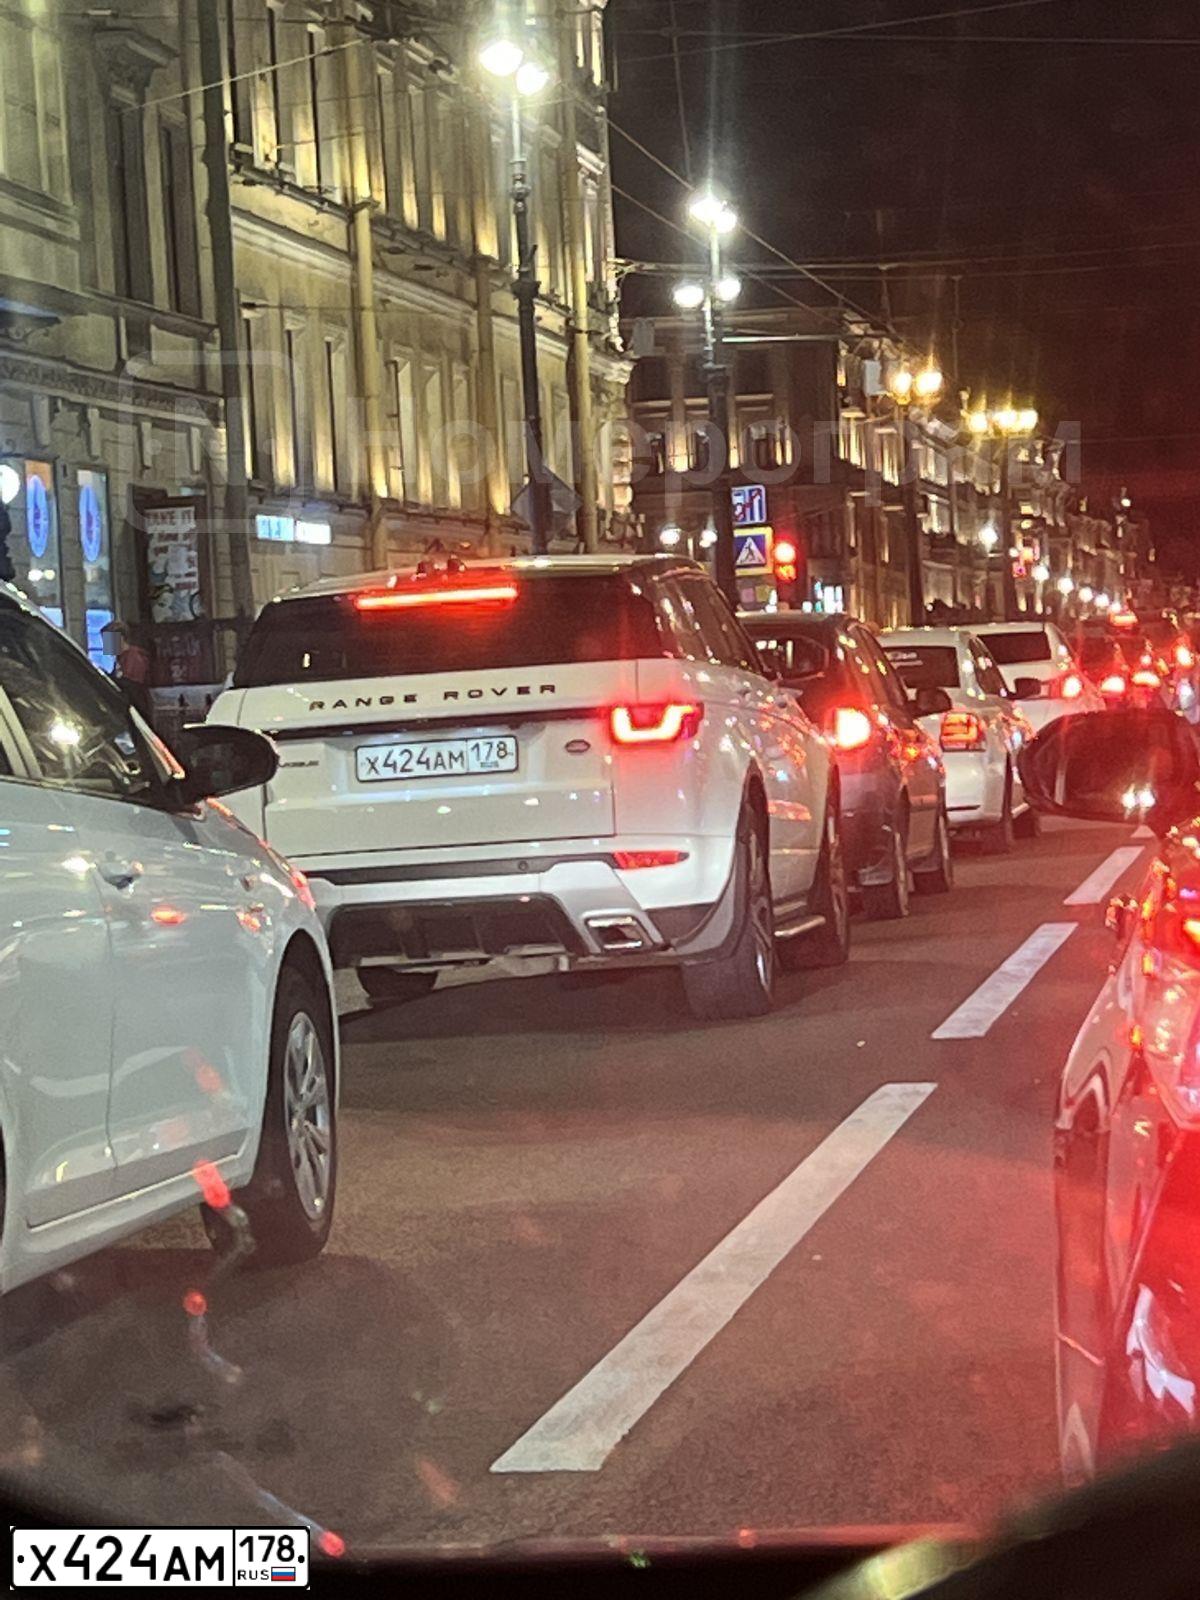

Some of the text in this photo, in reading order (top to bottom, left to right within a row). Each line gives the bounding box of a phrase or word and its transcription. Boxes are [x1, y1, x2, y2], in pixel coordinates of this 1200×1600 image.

[309, 685, 556, 711] RANGE ROVER
[470, 741, 508, 762] 178
